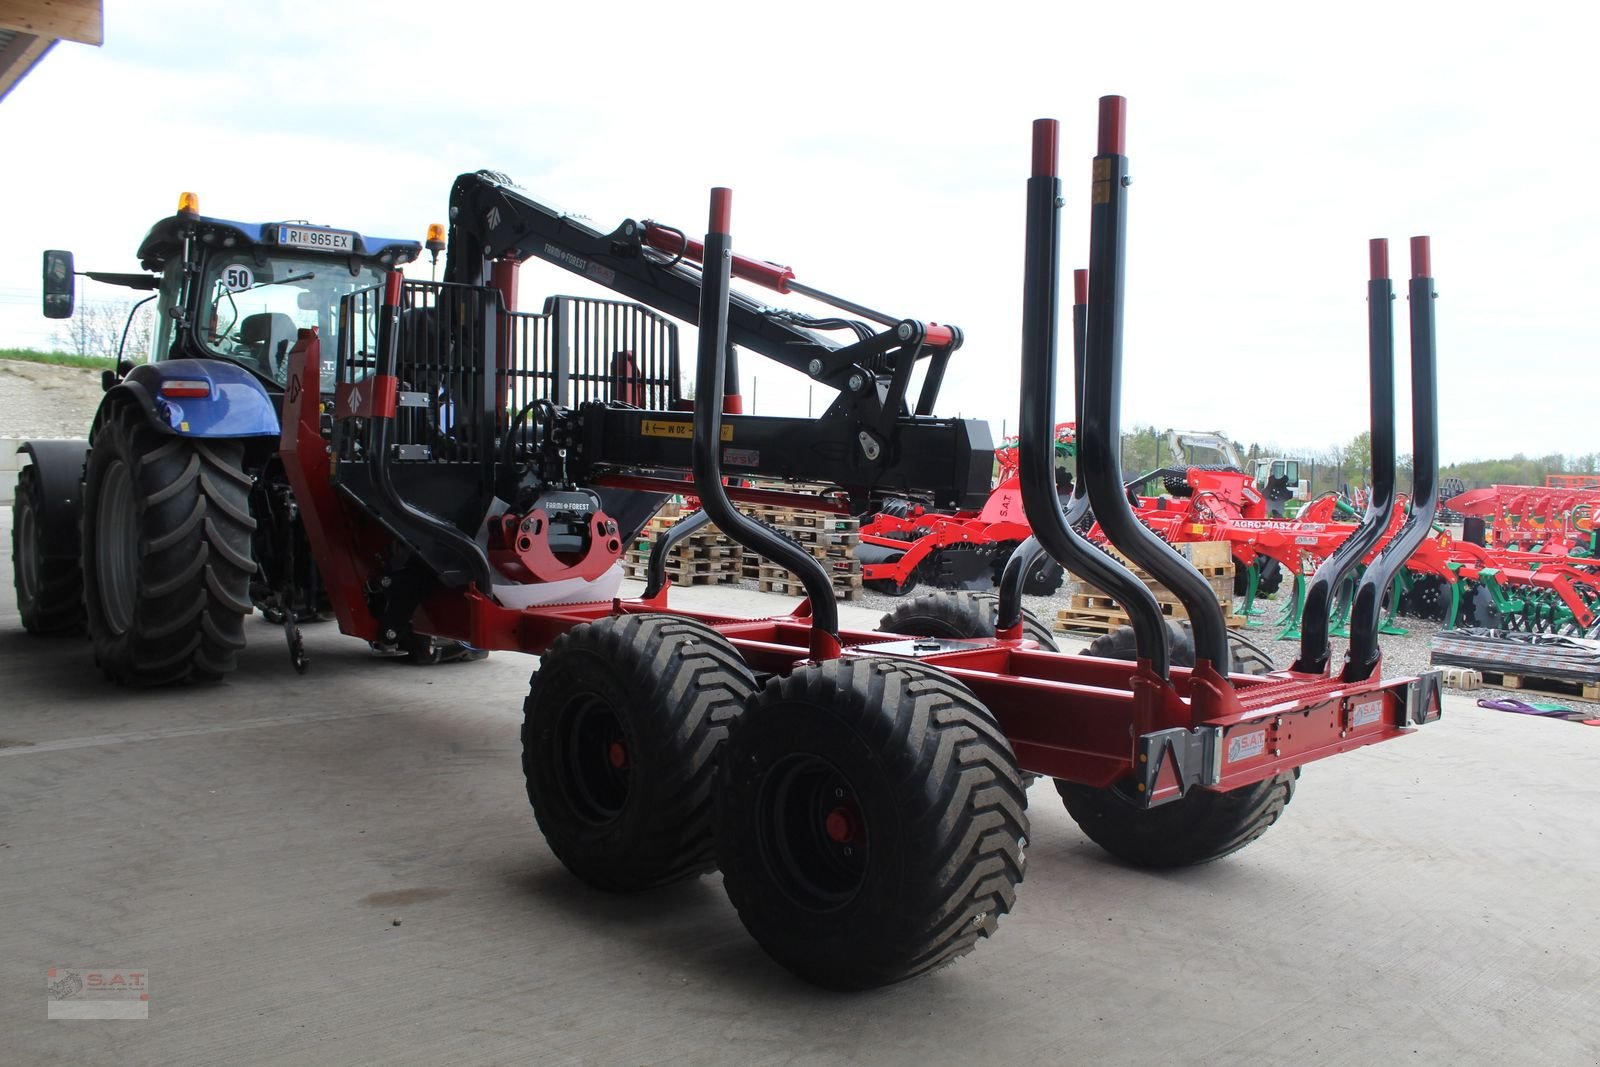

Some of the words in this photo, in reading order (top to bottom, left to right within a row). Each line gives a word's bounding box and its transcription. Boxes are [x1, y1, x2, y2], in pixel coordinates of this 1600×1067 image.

[290, 230, 302, 243] RI
[565, 253, 587, 270] FOREST
[228, 269, 249, 287] 50
[568, 502, 590, 510] FOREST
